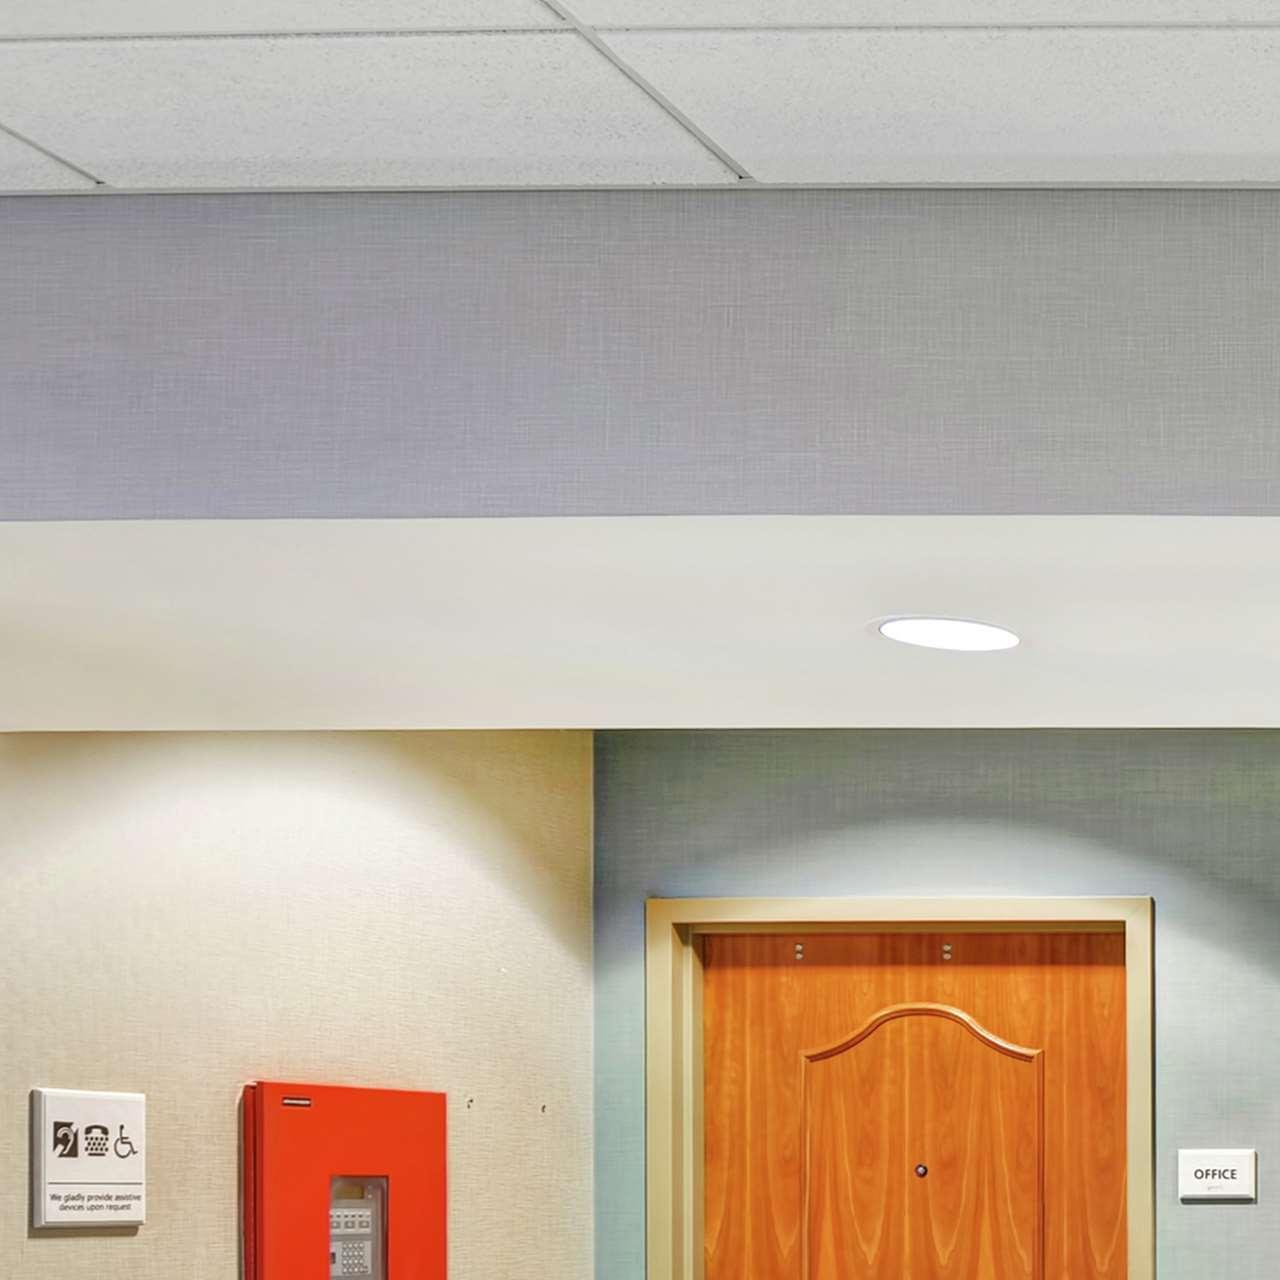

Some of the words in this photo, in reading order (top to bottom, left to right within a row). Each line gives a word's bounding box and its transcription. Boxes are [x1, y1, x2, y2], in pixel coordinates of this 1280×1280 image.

[1194, 1168, 1238, 1180] OFFICE
[87, 1193, 113, 1203] provide
[86, 1204, 105, 1212] upon
